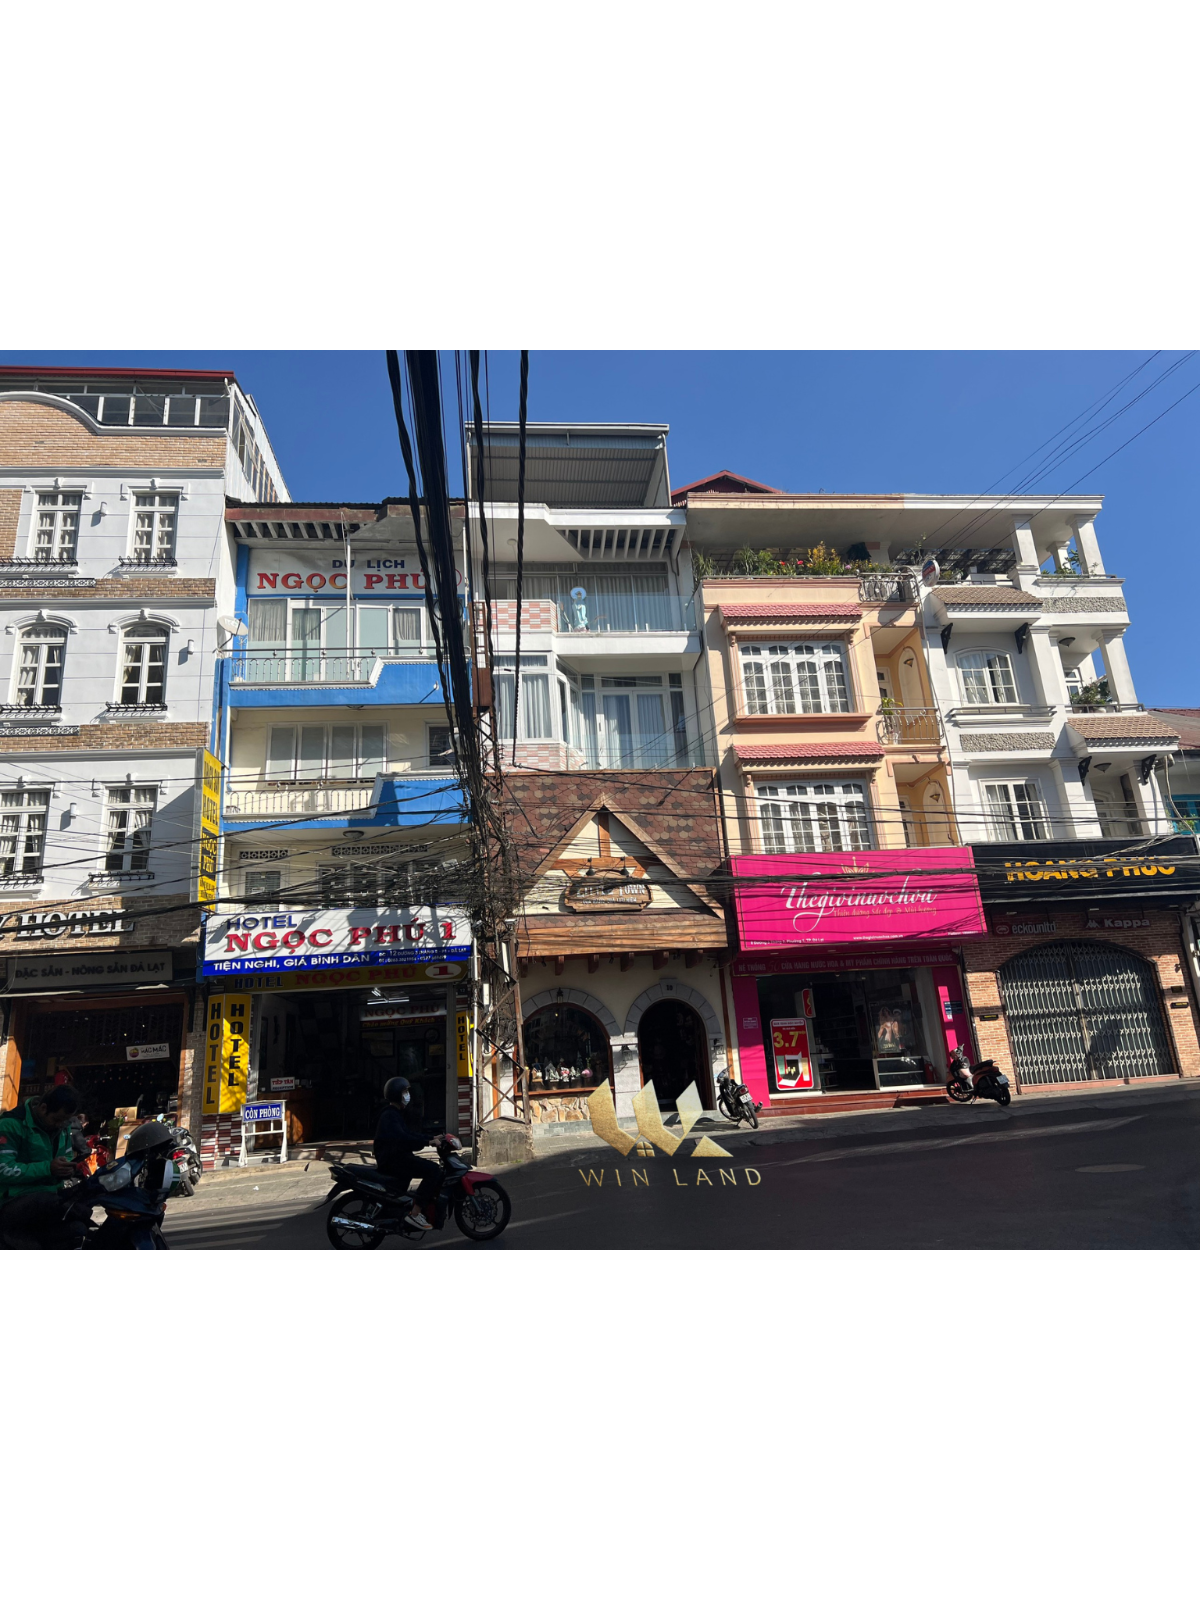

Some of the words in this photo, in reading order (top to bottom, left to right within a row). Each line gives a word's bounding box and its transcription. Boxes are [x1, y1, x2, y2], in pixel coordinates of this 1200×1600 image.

[367, 559, 405, 571] LỊCH
[257, 573, 348, 593] NGỌC
[17, 909, 134, 937] HOTEL
[226, 915, 297, 930] HOTEL
[1104, 918, 1150, 929] Kappa
[224, 929, 333, 954] NGỌC
[348, 917, 426, 945] PHÚ
[441, 922, 456, 939] 1
[214, 961, 240, 971] TIỆN
[245, 960, 280, 968] NGHI,
[284, 956, 307, 966] GIÁ
[311, 955, 338, 965] BÌNH
[342, 954, 370, 963] DÂN
[15, 967, 38, 980] ĐẶC
[41, 964, 63, 976] SẢN
[72, 964, 104, 976] NÔNG
[234, 976, 284, 989] HOTEL
[295, 970, 360, 986] NGỌC
[368, 964, 417, 980] PHÚ
[433, 966, 454, 976] 1
[364, 1008, 406, 1018] NGỌC
[228, 1004, 245, 1086] HOTEL
[457, 1016, 466, 1060] HOTEL
[774, 1032, 799, 1048] 3.7
[206, 1002, 222, 1104] HOTEL
[245, 1108, 258, 1120] CÒN
[260, 1106, 280, 1118] PHÒNG
